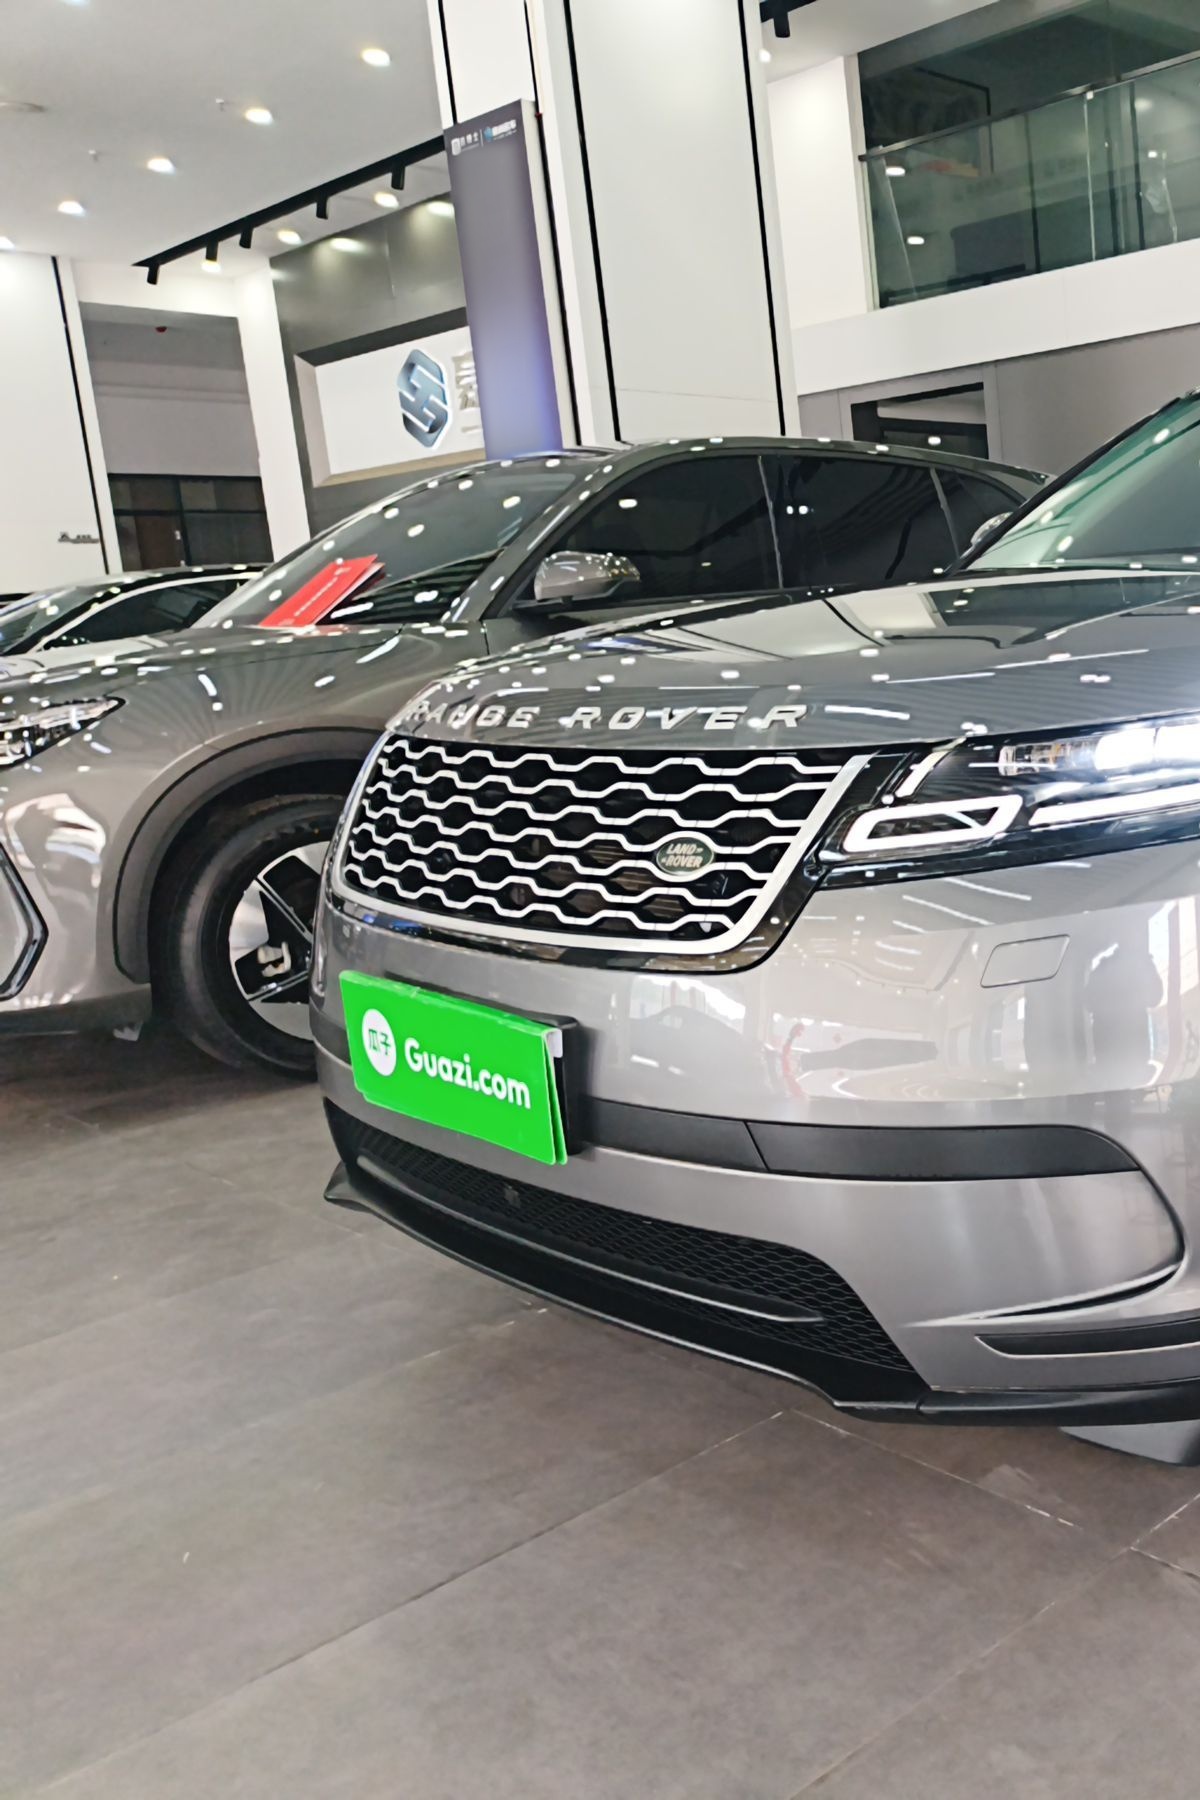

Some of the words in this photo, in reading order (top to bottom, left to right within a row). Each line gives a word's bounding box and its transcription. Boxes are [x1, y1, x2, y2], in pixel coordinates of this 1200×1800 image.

[406, 700, 541, 729] RANGE
[565, 704, 807, 730] ROVER
[368, 1028, 391, 1056] 瓜子
[404, 1037, 531, 1110] Guazi.com
